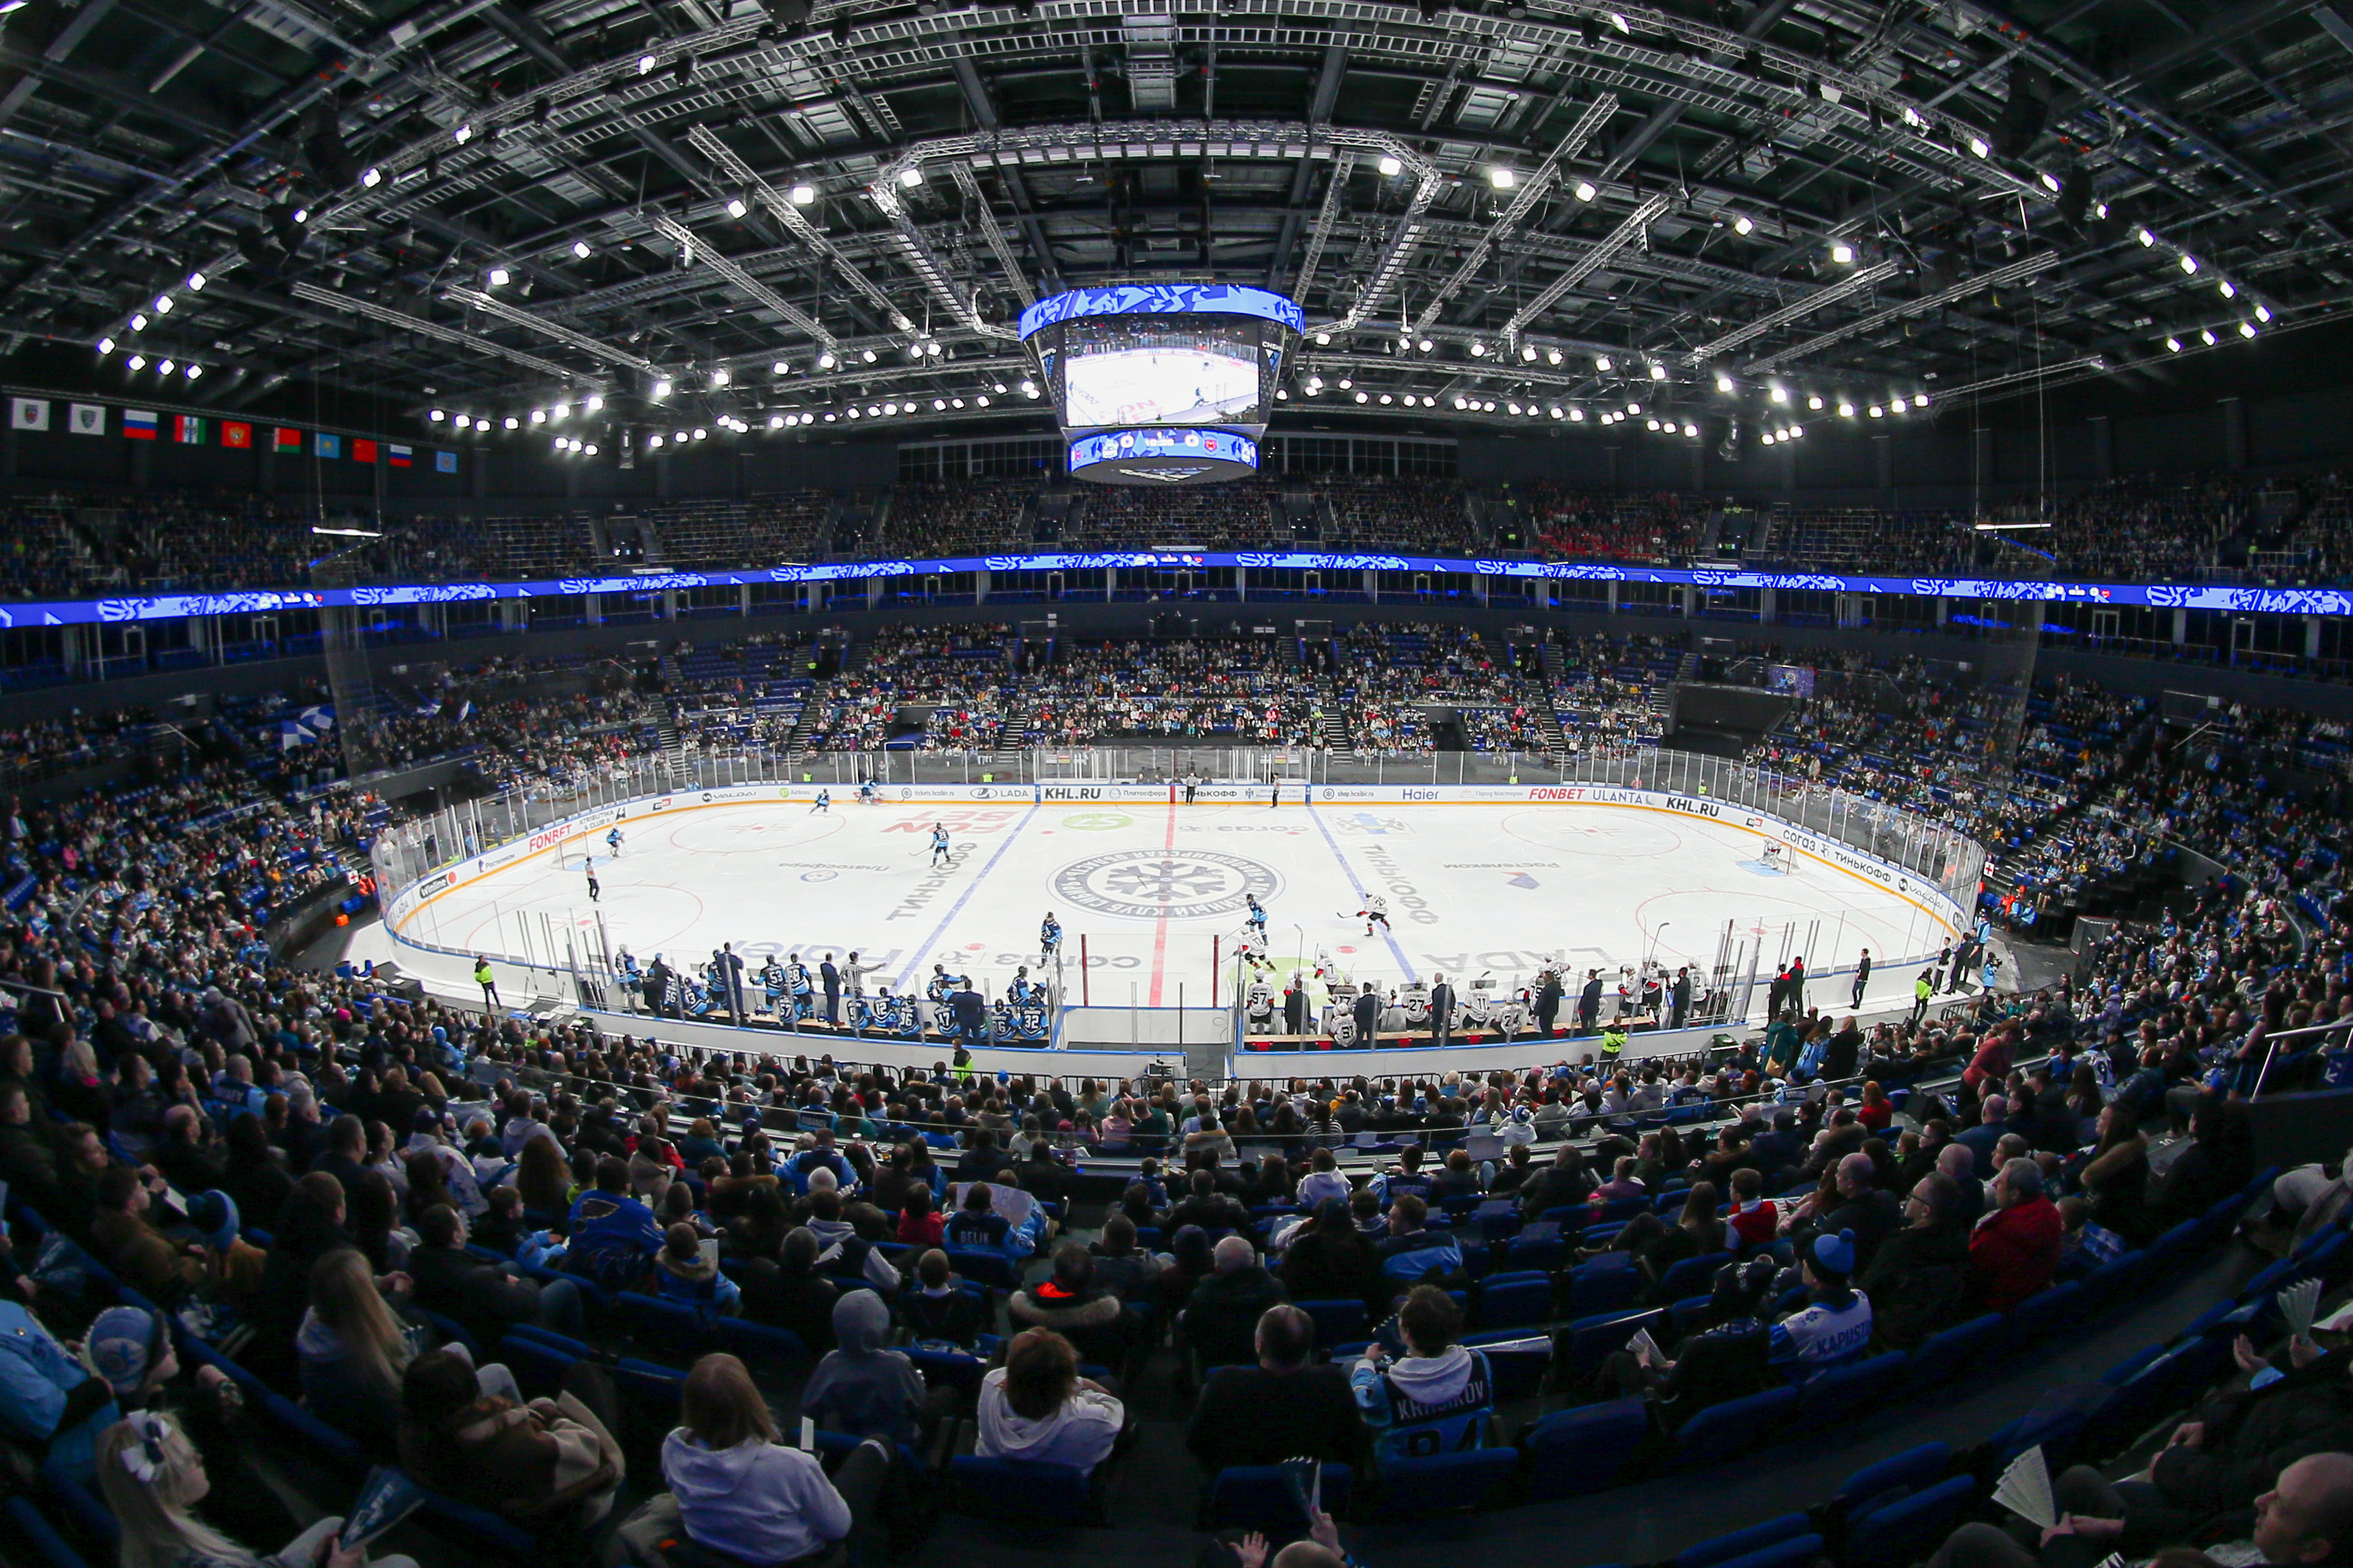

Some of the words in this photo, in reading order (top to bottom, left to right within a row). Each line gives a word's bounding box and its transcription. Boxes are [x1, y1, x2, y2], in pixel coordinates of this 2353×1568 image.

[1000, 789, 1029, 798] LADA
[1045, 788, 1102, 800] KHL.RU
[1180, 789, 1237, 798] ТНЬКОФФ
[1403, 788, 1440, 800] Haier
[1528, 788, 1586, 800] FONBET
[1592, 789, 1643, 805] ULANTA
[1666, 797, 1720, 817] KHL.RU
[579, 809, 615, 825] ATRIBUTIKA
[1835, 851, 1891, 883] ТИНЬКОФФ
[1360, 843, 1439, 925] ТИНЬКОФФ
[1108, 903, 1166, 916] КЛУБ
[769, 970, 785, 984] 53
[876, 1002, 887, 1016] 12
[1409, 999, 1425, 1013] 27
[901, 1011, 913, 1026] 96
[1024, 1015, 1040, 1029] 32
[960, 1231, 990, 1245] BELIK
